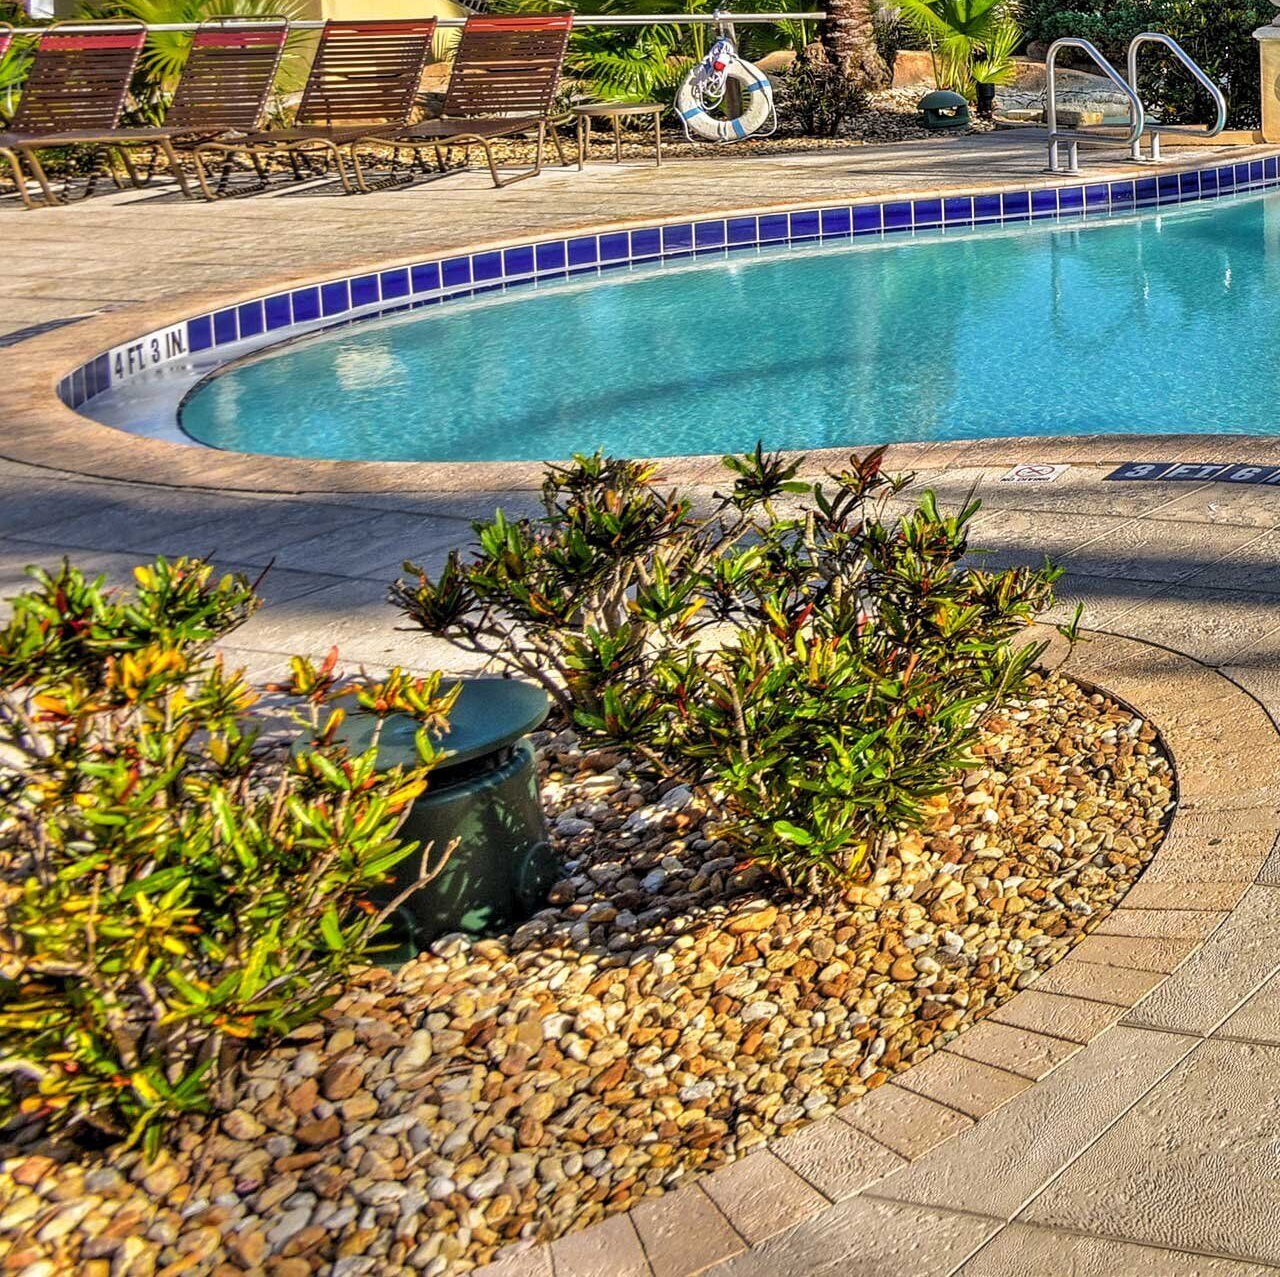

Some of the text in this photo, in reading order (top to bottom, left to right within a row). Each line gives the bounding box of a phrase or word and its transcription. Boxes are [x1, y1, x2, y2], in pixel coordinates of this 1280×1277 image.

[115, 329, 186, 379] 4 FT. 3 IN.
[1124, 464, 1156, 478] 3
[1164, 464, 1225, 479] FT.
[1230, 467, 1262, 481] 6
